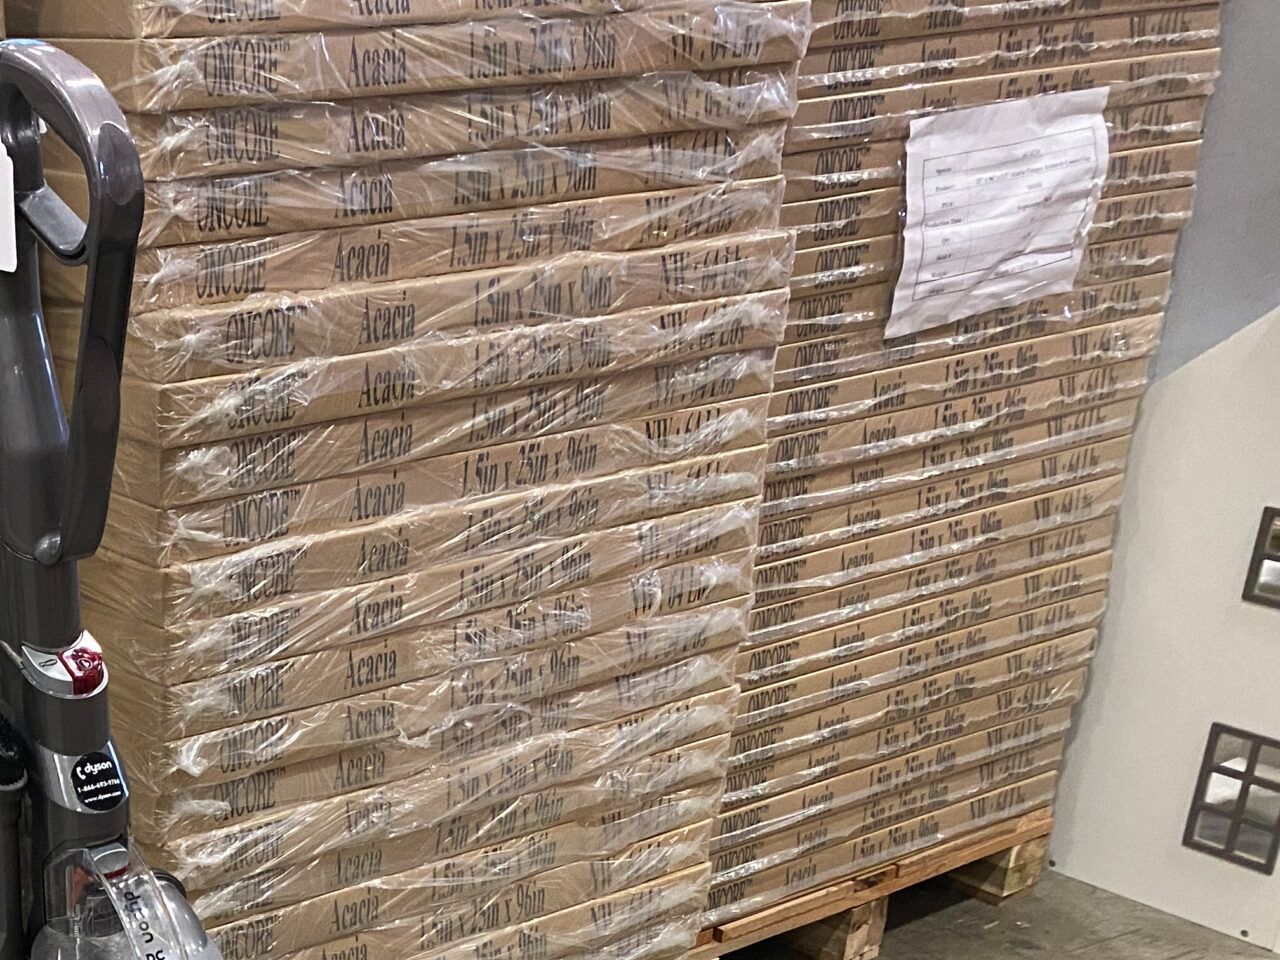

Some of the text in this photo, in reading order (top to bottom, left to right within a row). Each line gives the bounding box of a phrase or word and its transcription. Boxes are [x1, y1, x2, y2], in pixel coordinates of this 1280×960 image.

[347, 32, 407, 88] Acacia
[347, 100, 405, 152] Acacia
[332, 229, 390, 283] Acacia
[359, 290, 415, 345] Acacia
[358, 356, 415, 408] Acacia
[356, 412, 413, 464] Acacia
[350, 470, 405, 522] Acacia
[350, 586, 403, 636] Acacia
[344, 640, 396, 690] Acacia
[346, 694, 394, 742] Acacia
[84, 761, 112, 775] dyson
[334, 737, 385, 790] Acacia
[329, 886, 379, 934] Acacia
